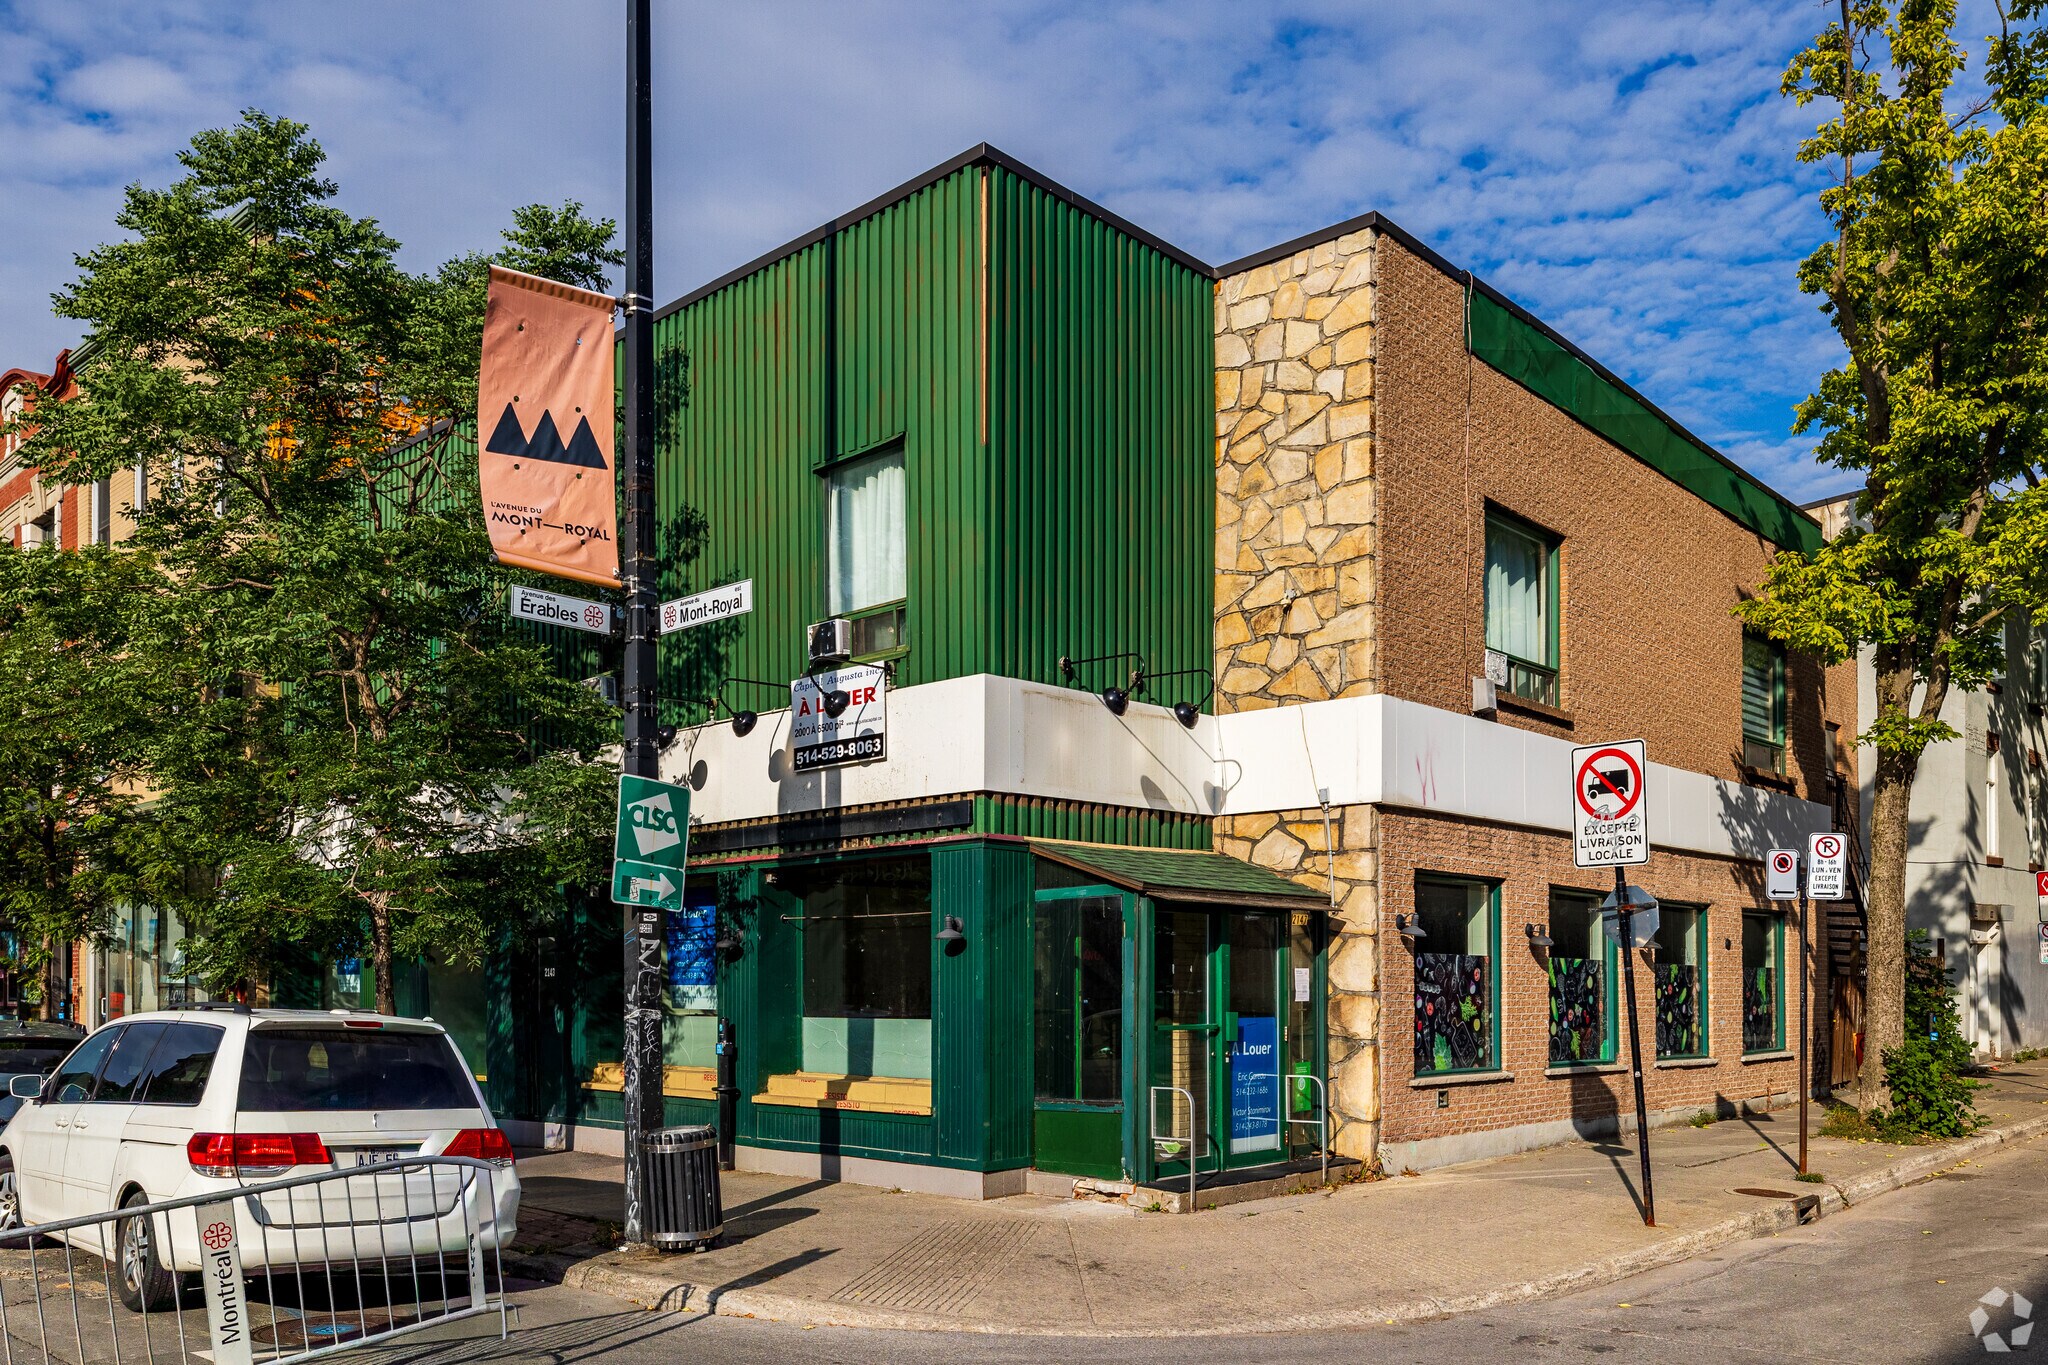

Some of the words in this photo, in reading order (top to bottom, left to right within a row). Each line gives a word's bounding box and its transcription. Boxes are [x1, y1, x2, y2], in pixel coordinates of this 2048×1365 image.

[491, 501, 528, 512] L'AVENUE
[521, 589, 544, 600] Avenue
[545, 593, 556, 602] des
[680, 598, 694, 607] Avenue
[520, 595, 578, 623] Érables
[679, 593, 743, 623] Mont-Royal
[826, 671, 863, 686] Augusta
[798, 697, 811, 718] À
[816, 686, 877, 713] LER
[796, 738, 881, 765] 514-529-8063
[628, 804, 676, 835] CLSC
[1580, 834, 1642, 849] LIVRAISON
[1588, 849, 1634, 861] LOCALE
[1292, 914, 1308, 925] 2147
[1243, 1041, 1272, 1056] Louer
[1237, 1072, 1248, 1081] Eric
[823, 1091, 848, 1101] RESISTO
[210, 1249, 241, 1345] Montréal
